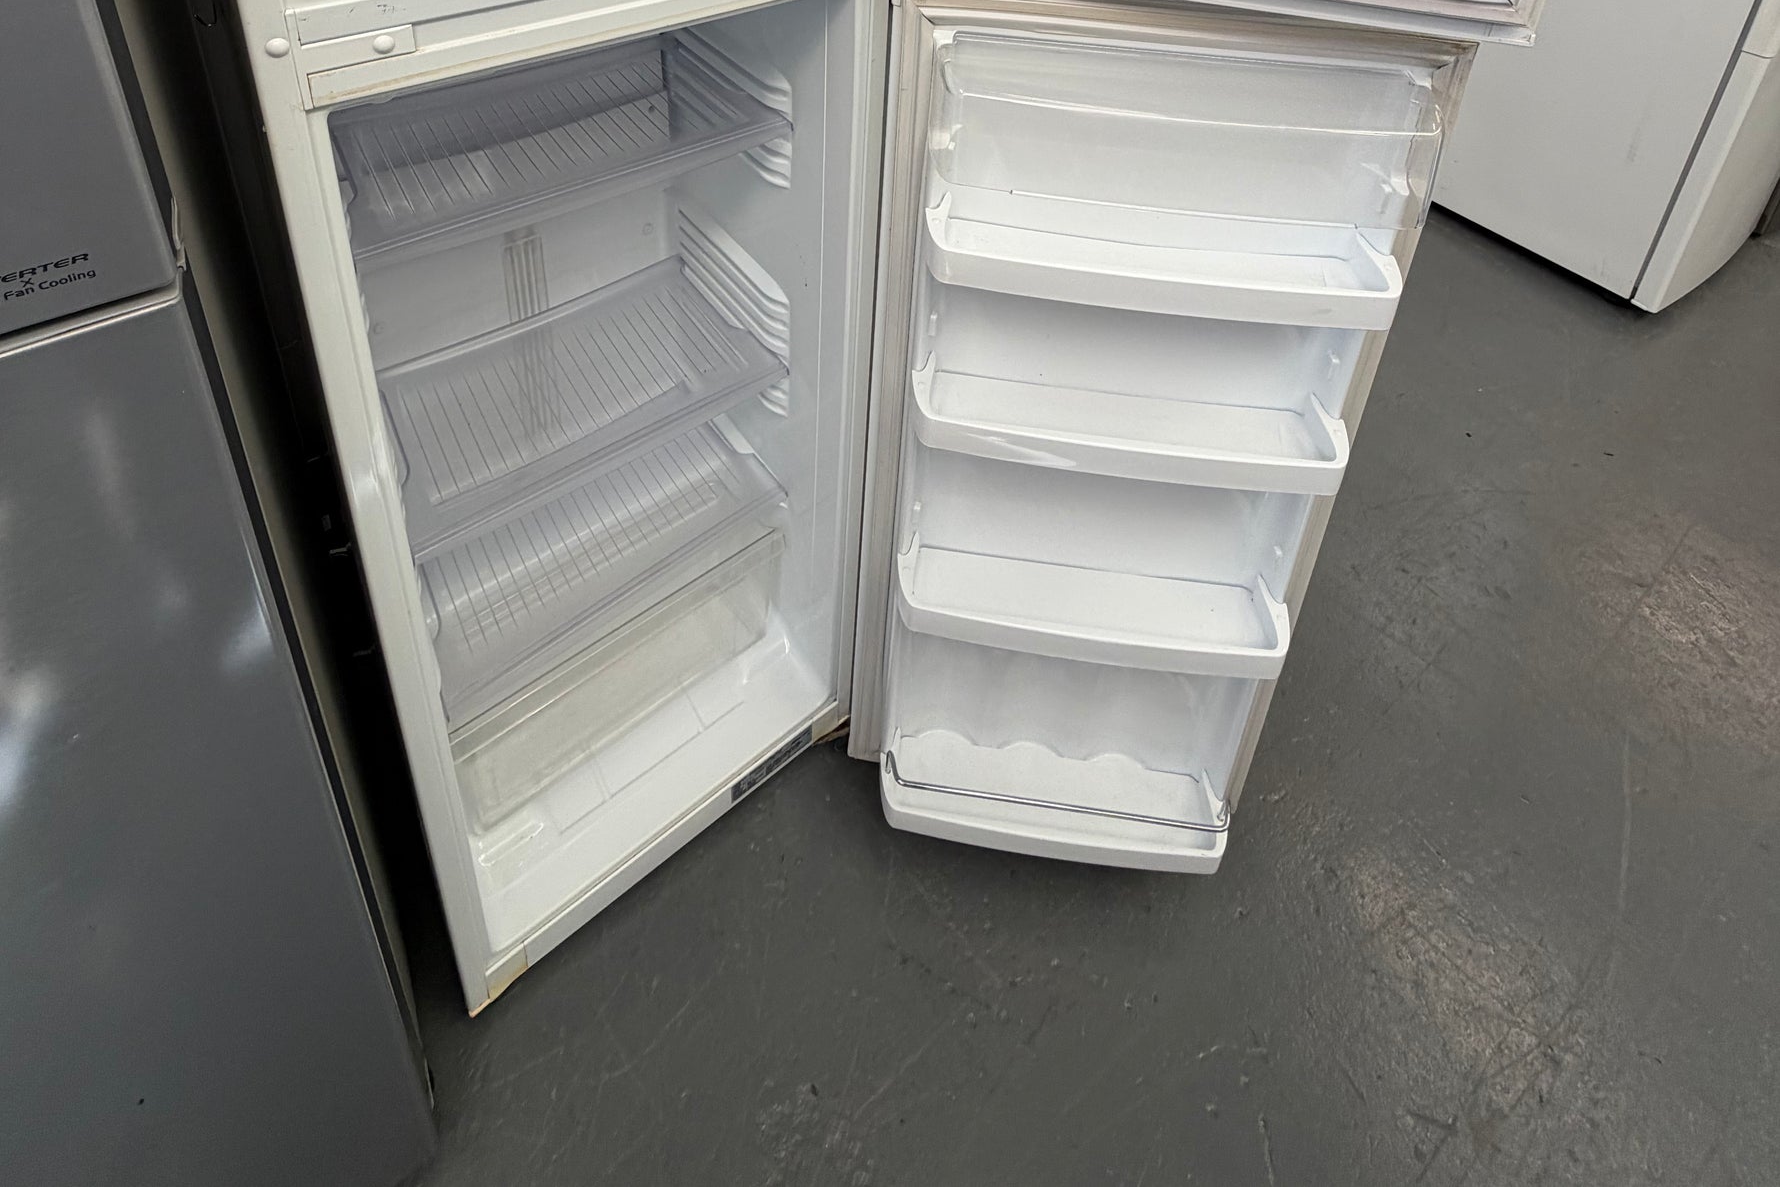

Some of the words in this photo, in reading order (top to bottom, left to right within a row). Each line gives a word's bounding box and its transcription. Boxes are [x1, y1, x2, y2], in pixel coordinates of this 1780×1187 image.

[0, 253, 89, 283] ERTER
[4, 287, 35, 301] Fan
[38, 269, 97, 290] Cooling
